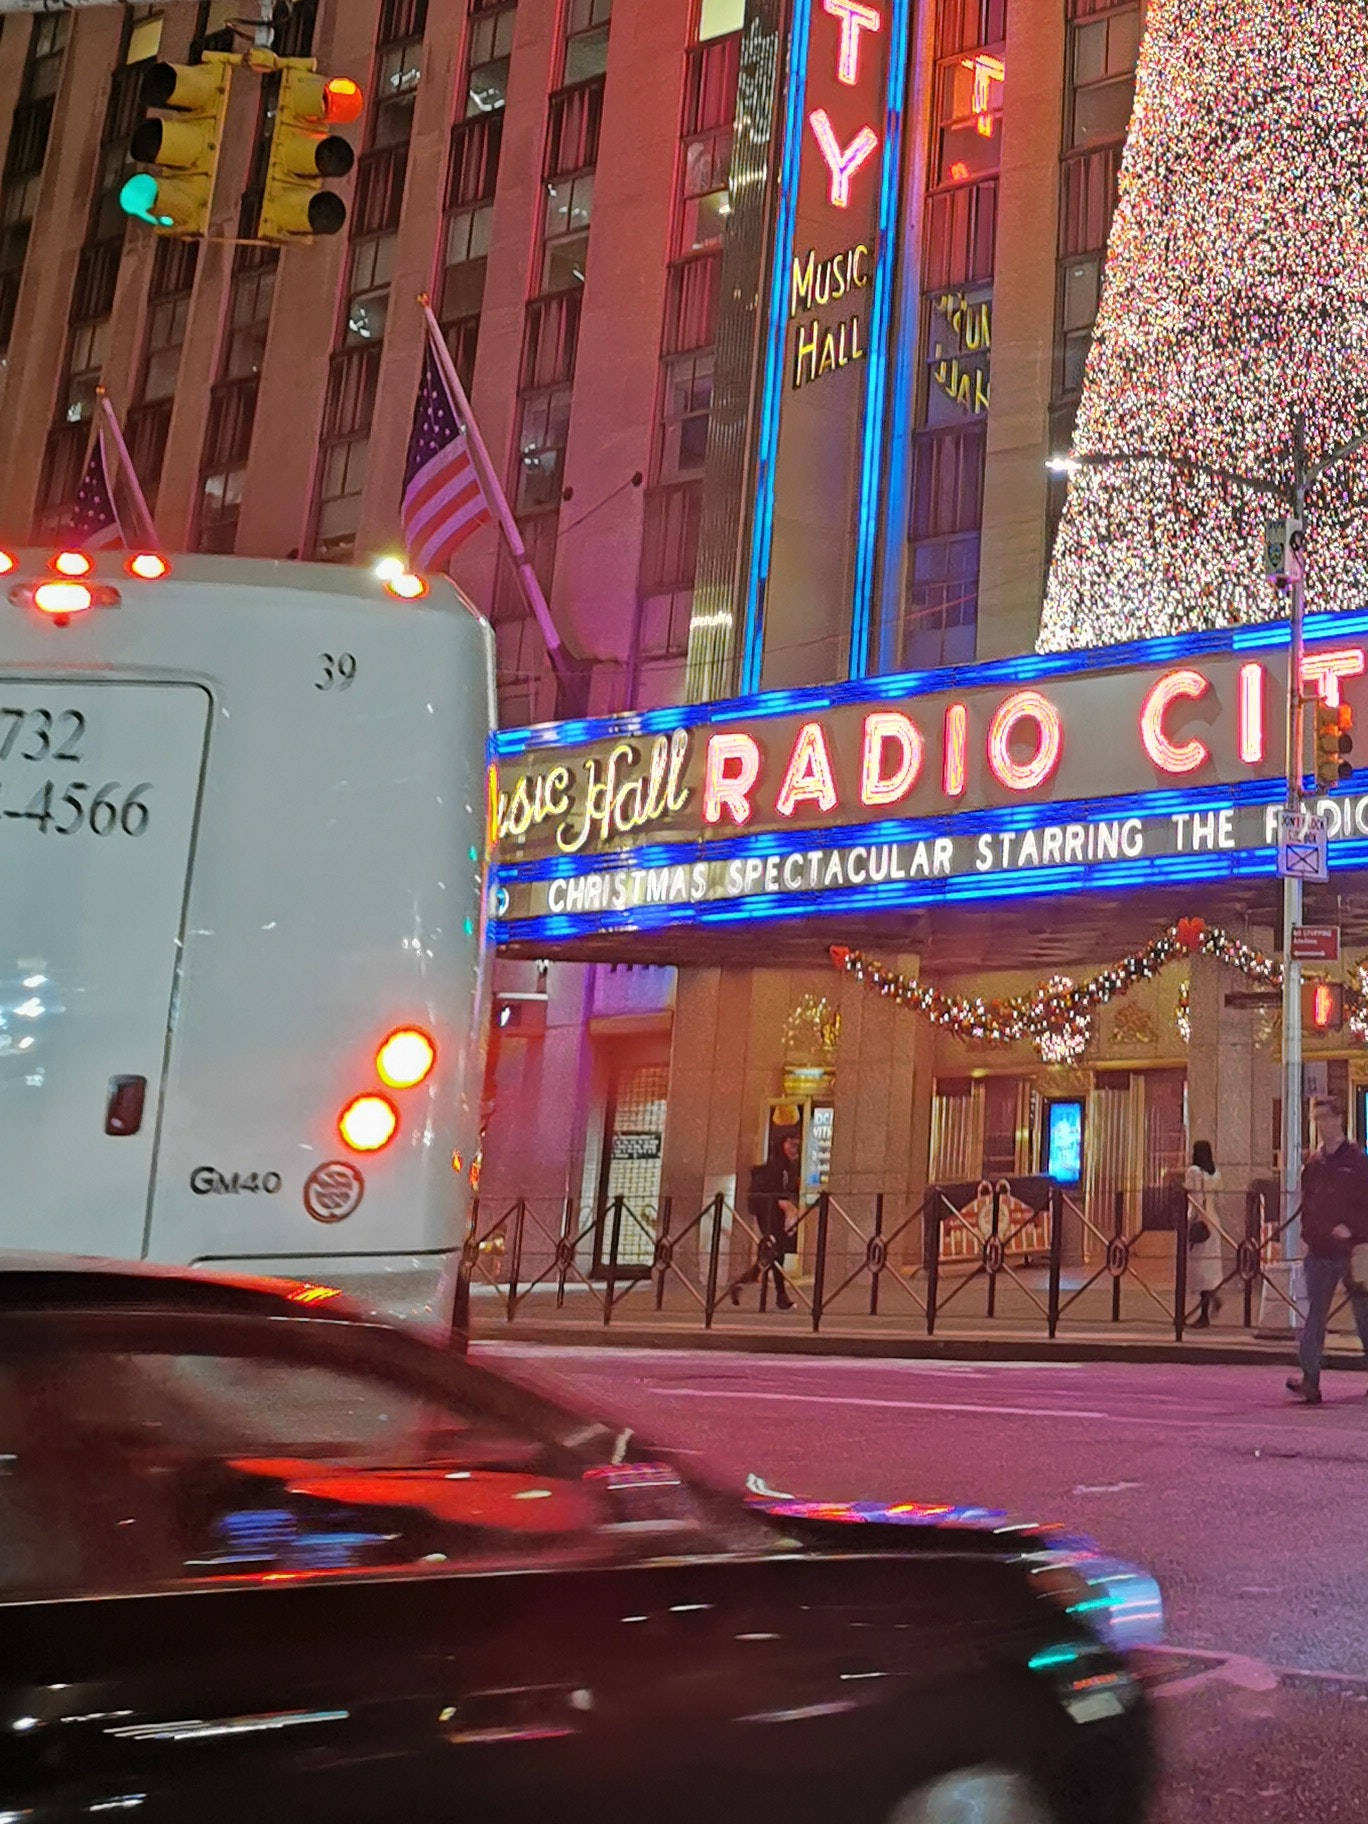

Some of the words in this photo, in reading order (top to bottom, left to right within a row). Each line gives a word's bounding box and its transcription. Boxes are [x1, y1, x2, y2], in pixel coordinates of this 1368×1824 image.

[314, 651, 357, 692] 39
[0, 706, 86, 763] 732
[701, 688, 1064, 828] RADIO
[556, 727, 690, 852] Hall
[547, 861, 708, 914] CHRISTMAS
[728, 836, 952, 896] SPECTACULAR
[975, 817, 1144, 873] STARRING
[1170, 806, 1236, 850] THE
